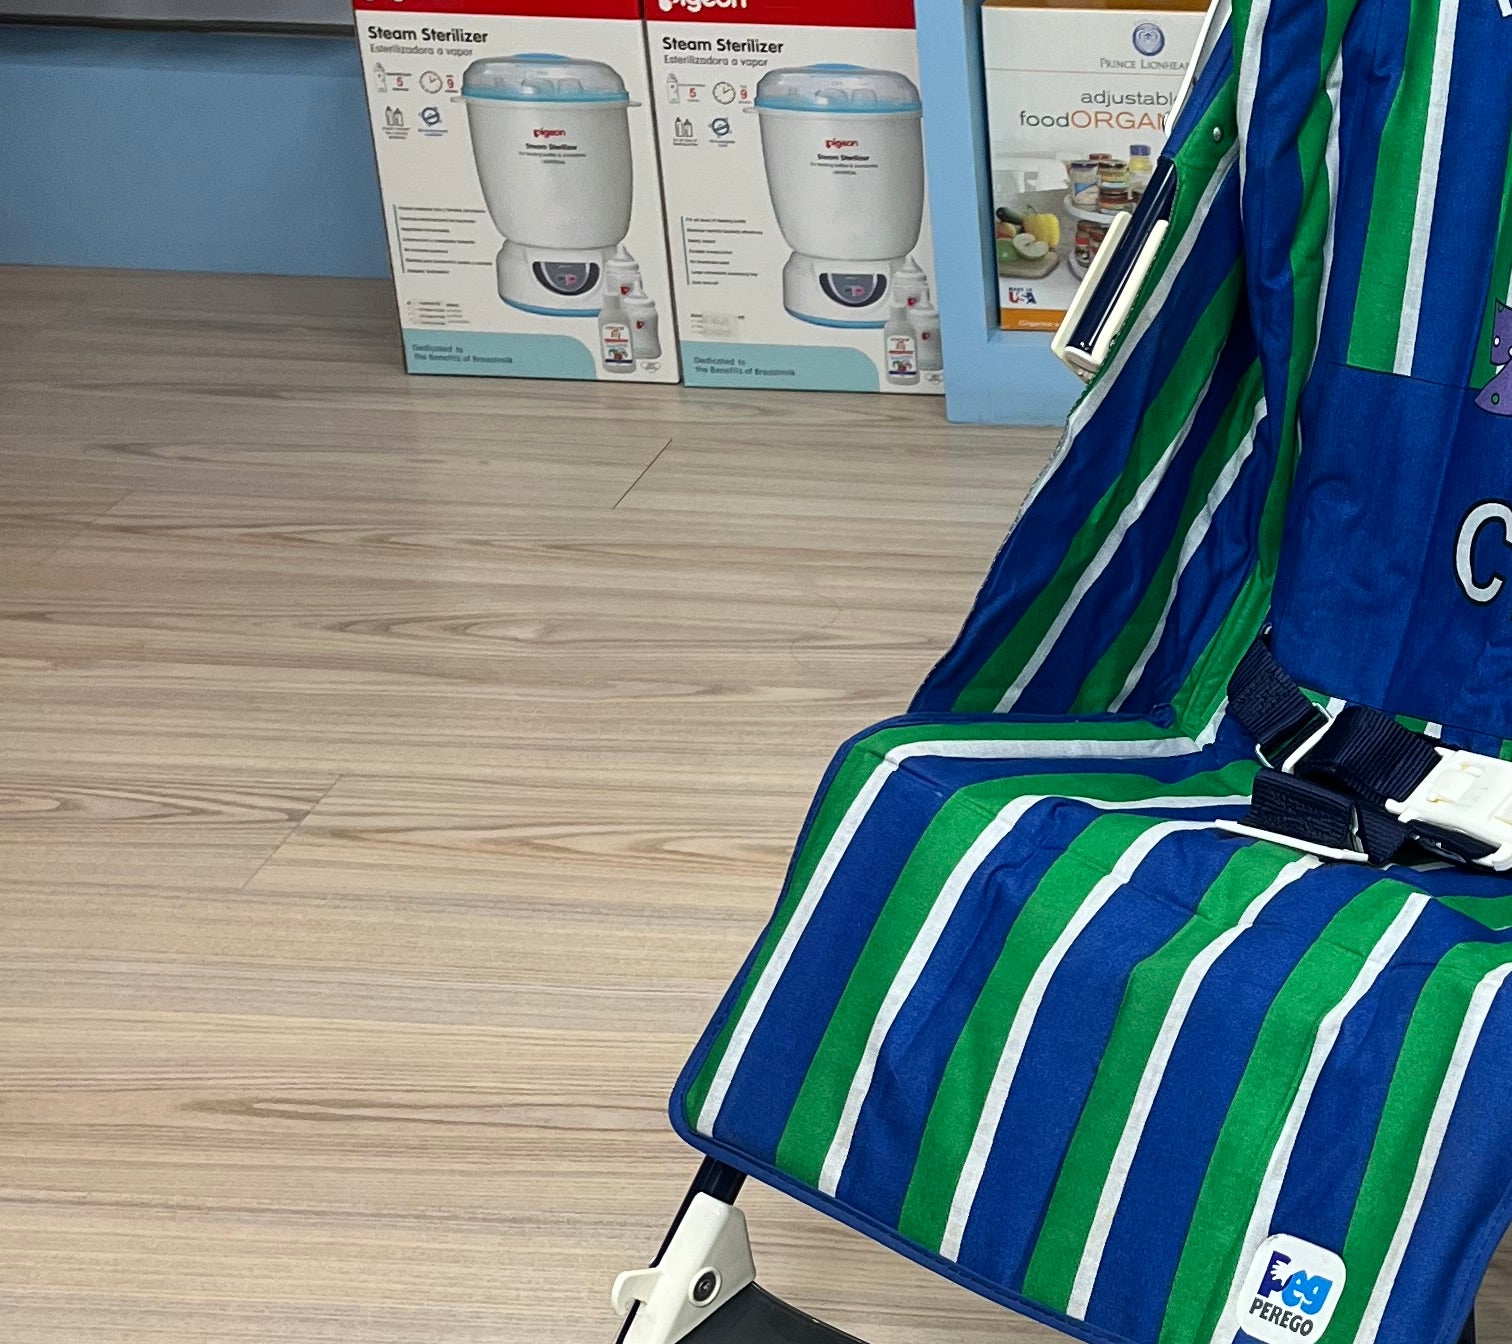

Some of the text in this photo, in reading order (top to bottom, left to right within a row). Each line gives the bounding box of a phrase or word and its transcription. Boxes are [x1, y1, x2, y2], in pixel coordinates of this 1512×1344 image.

[367, 26, 489, 43] Steam Sterilizer
[370, 43, 473, 57] Esterilizadora a vapor
[662, 36, 784, 54] Steam Sterilizer
[664, 55, 768, 68] Esterilizadora a vapor
[1100, 58, 1137, 70] PRINCE
[689, 87, 697, 98] 5
[740, 89, 748, 99] 9
[533, 127, 566, 138] pigeon
[825, 138, 859, 149] pigeon
[1256, 1250, 1334, 1316] Peg
[1249, 1296, 1314, 1337] PEREGO
